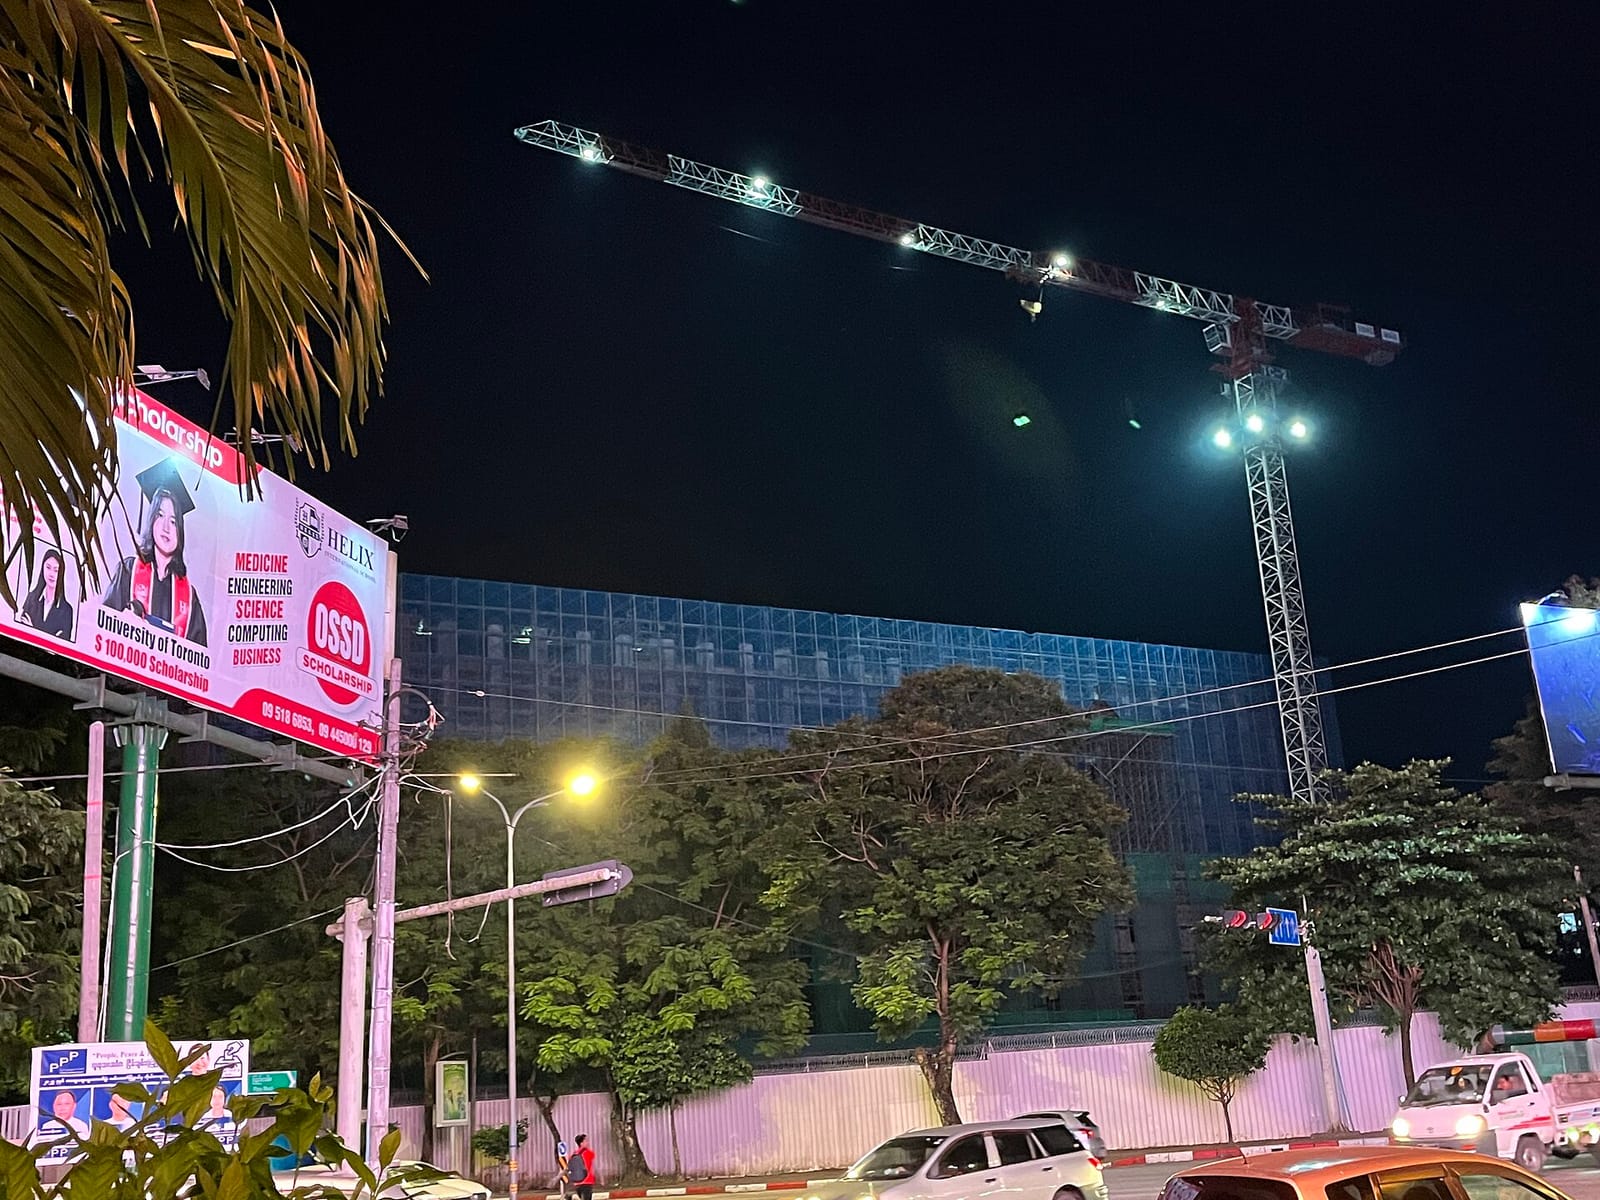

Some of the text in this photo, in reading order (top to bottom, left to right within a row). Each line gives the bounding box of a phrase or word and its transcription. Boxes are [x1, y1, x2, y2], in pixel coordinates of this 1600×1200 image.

[235, 552, 288, 573] MEDICINE
[327, 526, 375, 571] HELIX
[228, 577, 293, 596] ENGINEERING
[235, 599, 284, 619] SCIENCE
[97, 608, 211, 670] University of Toronto
[228, 624, 288, 643] COMPUTING
[314, 602, 365, 666] OSSD
[94, 633, 209, 693] $ 100,000 Scholarship
[232, 647, 282, 666] BUSINESS
[302, 654, 373, 694] SCHOLARSHIP
[261, 701, 274, 719] 09
[274, 706, 291, 725] 518
[291, 711, 316, 737] 6853,
[318, 722, 330, 739] 09
[358, 737, 373, 754] 129
[48, 1050, 80, 1073] PPP
